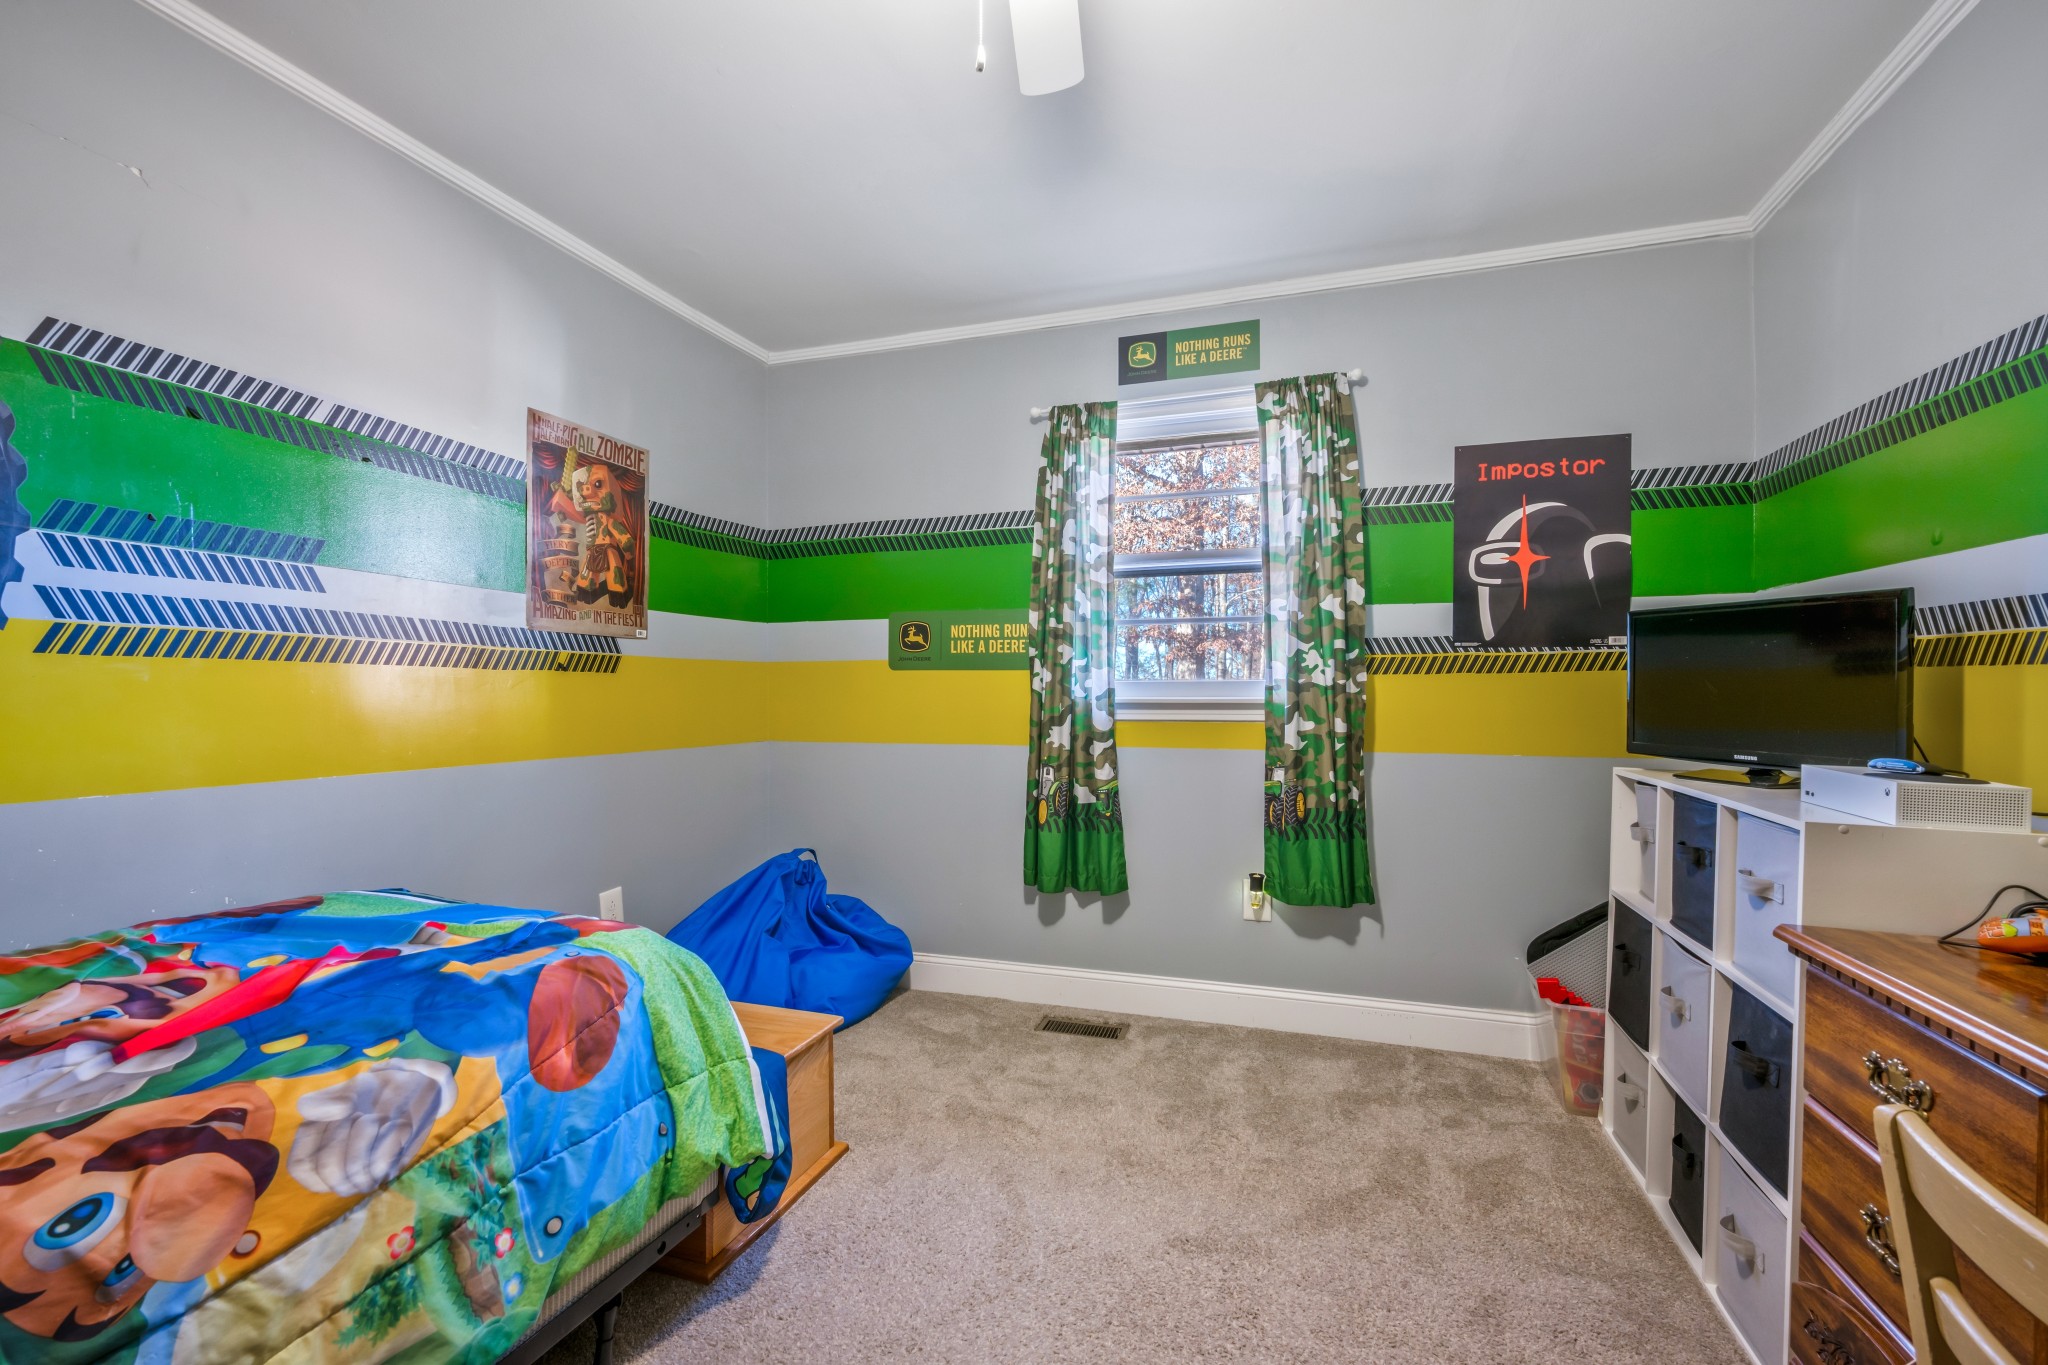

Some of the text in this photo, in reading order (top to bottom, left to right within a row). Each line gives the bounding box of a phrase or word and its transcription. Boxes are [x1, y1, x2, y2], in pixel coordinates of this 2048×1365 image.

[1175, 333, 1251, 354] NOTHING RUNS
[1175, 347, 1243, 367] LIKE A DEERE
[578, 432, 596, 454] ALL
[1478, 457, 1606, 482] Impostor
[532, 587, 644, 628] AMAZING AND IN THE FLESH
[950, 623, 1030, 638] NOTHING RUN
[950, 639, 1026, 654] LIKE A DEERE
